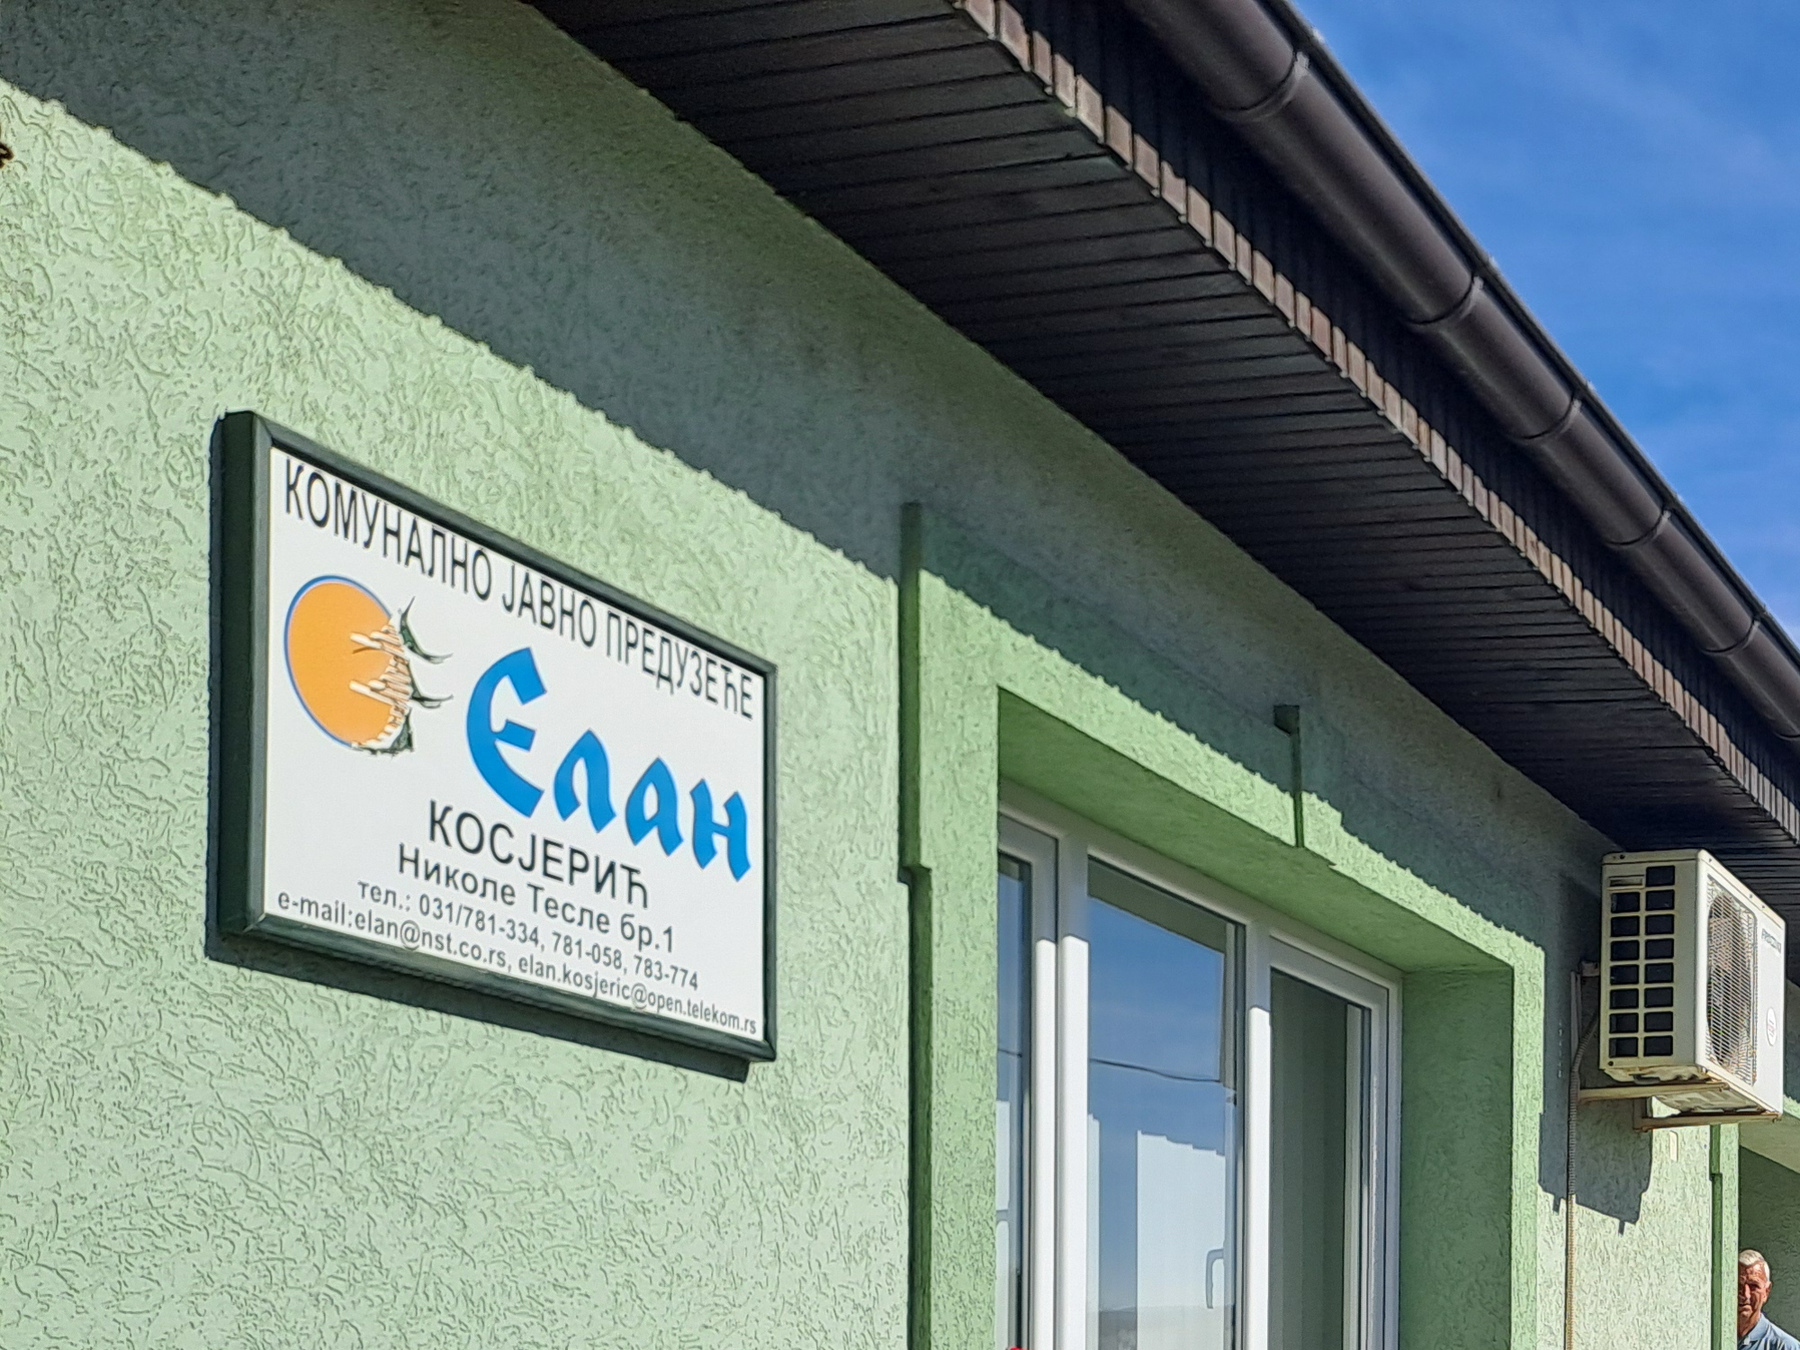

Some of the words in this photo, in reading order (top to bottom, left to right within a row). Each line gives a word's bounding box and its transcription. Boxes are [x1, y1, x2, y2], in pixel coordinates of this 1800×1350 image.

[286, 457, 493, 601] КОМУНАЛНО
[502, 564, 597, 648] ЈАВНО
[606, 610, 753, 721] ПРЕДУЗЕЋЕ
[466, 646, 751, 882] Елан
[398, 842, 516, 907] Николе
[526, 883, 610, 934] Тесле
[620, 913, 674, 953] бр.1
[428, 799, 648, 909] КОСЈЕРИЋ
[357, 880, 411, 912] тел.:
[419, 893, 546, 952] 031/781-334,
[551, 931, 628, 975] 781-058,
[633, 954, 699, 991] 783-774
[518, 954, 757, 1035] elan.kosjeric@open.telekom.rs
